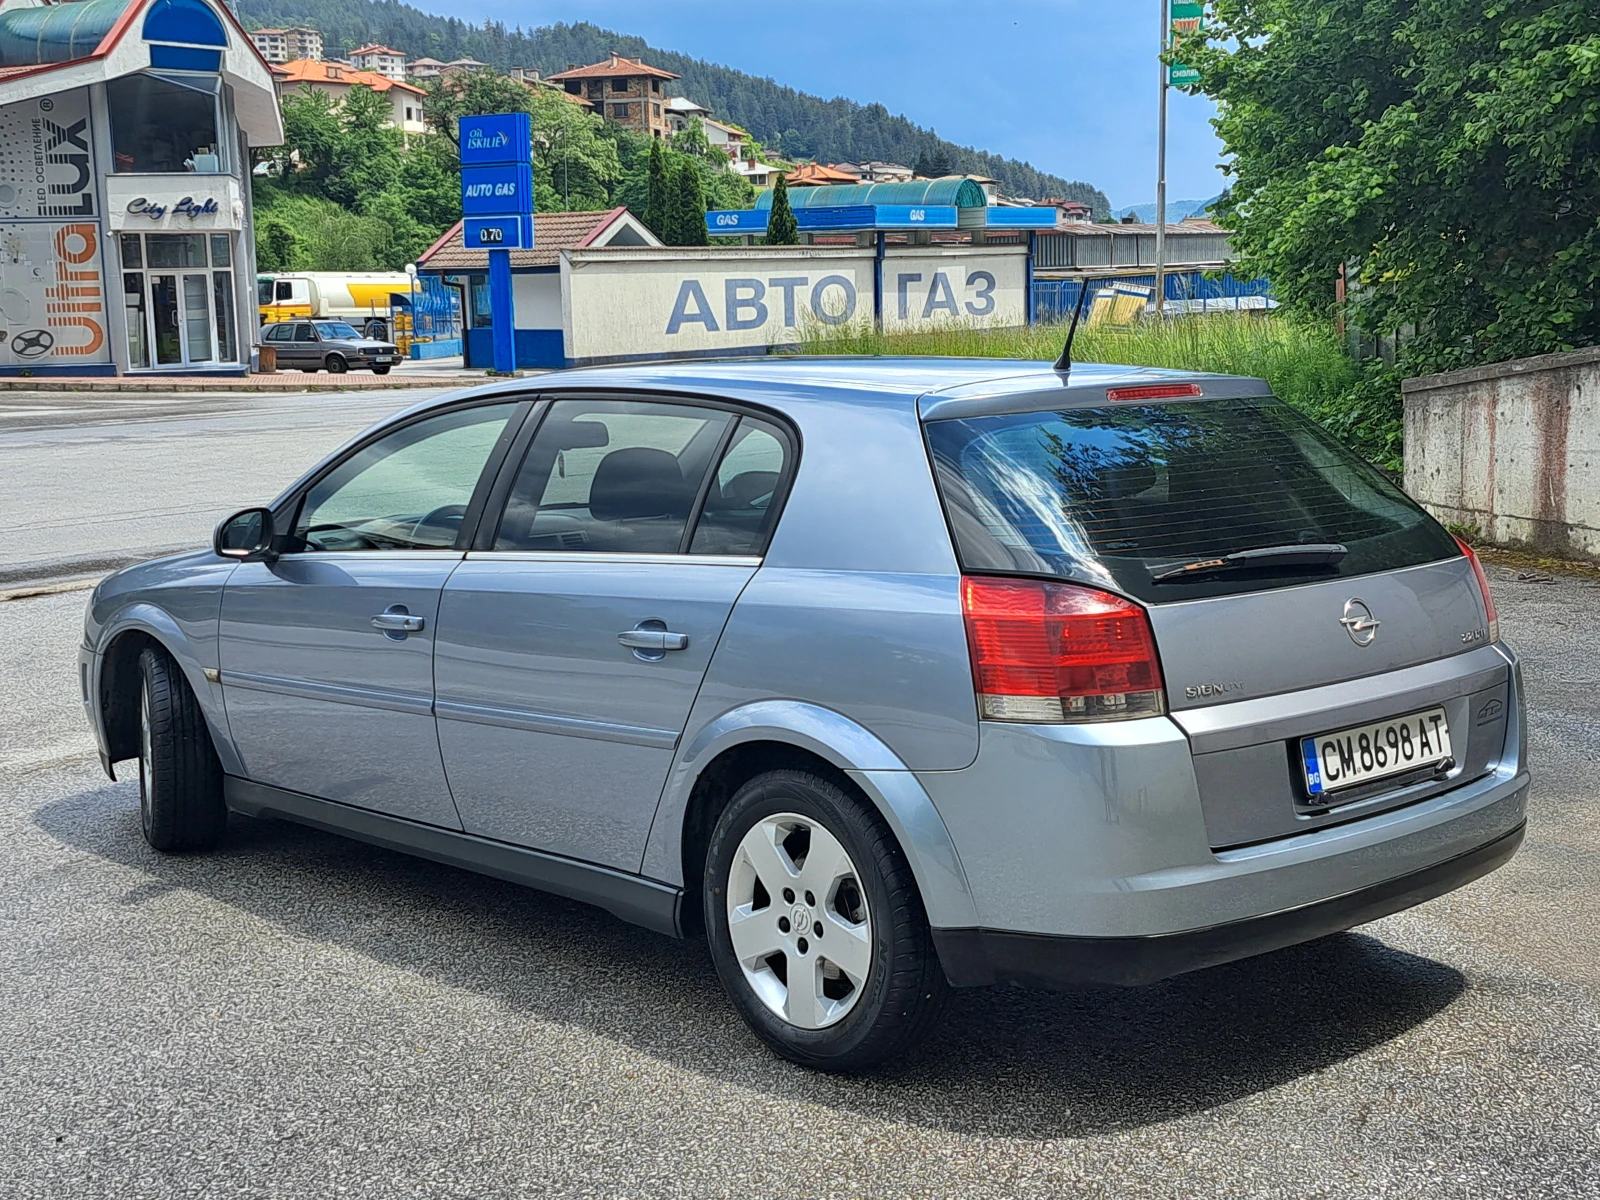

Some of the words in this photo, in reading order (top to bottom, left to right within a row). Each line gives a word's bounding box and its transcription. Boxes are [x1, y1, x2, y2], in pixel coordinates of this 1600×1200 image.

[31, 118, 45, 183] ОСВЕТЛЕНИЕ
[37, 188, 46, 205] LED
[465, 183, 493, 197] AUTO
[494, 182, 516, 196] GAS
[127, 198, 167, 219] City
[171, 196, 219, 219] Light
[909, 209, 925, 222] GAS
[716, 213, 739, 227] GAS
[480, 228, 502, 242] 0.70
[665, 274, 857, 335] АВТО
[897, 270, 996, 321] ГАЗ
[1358, 722, 1415, 772] 8698
[1419, 713, 1443, 759] AT
[1308, 772, 1320, 786] BG
